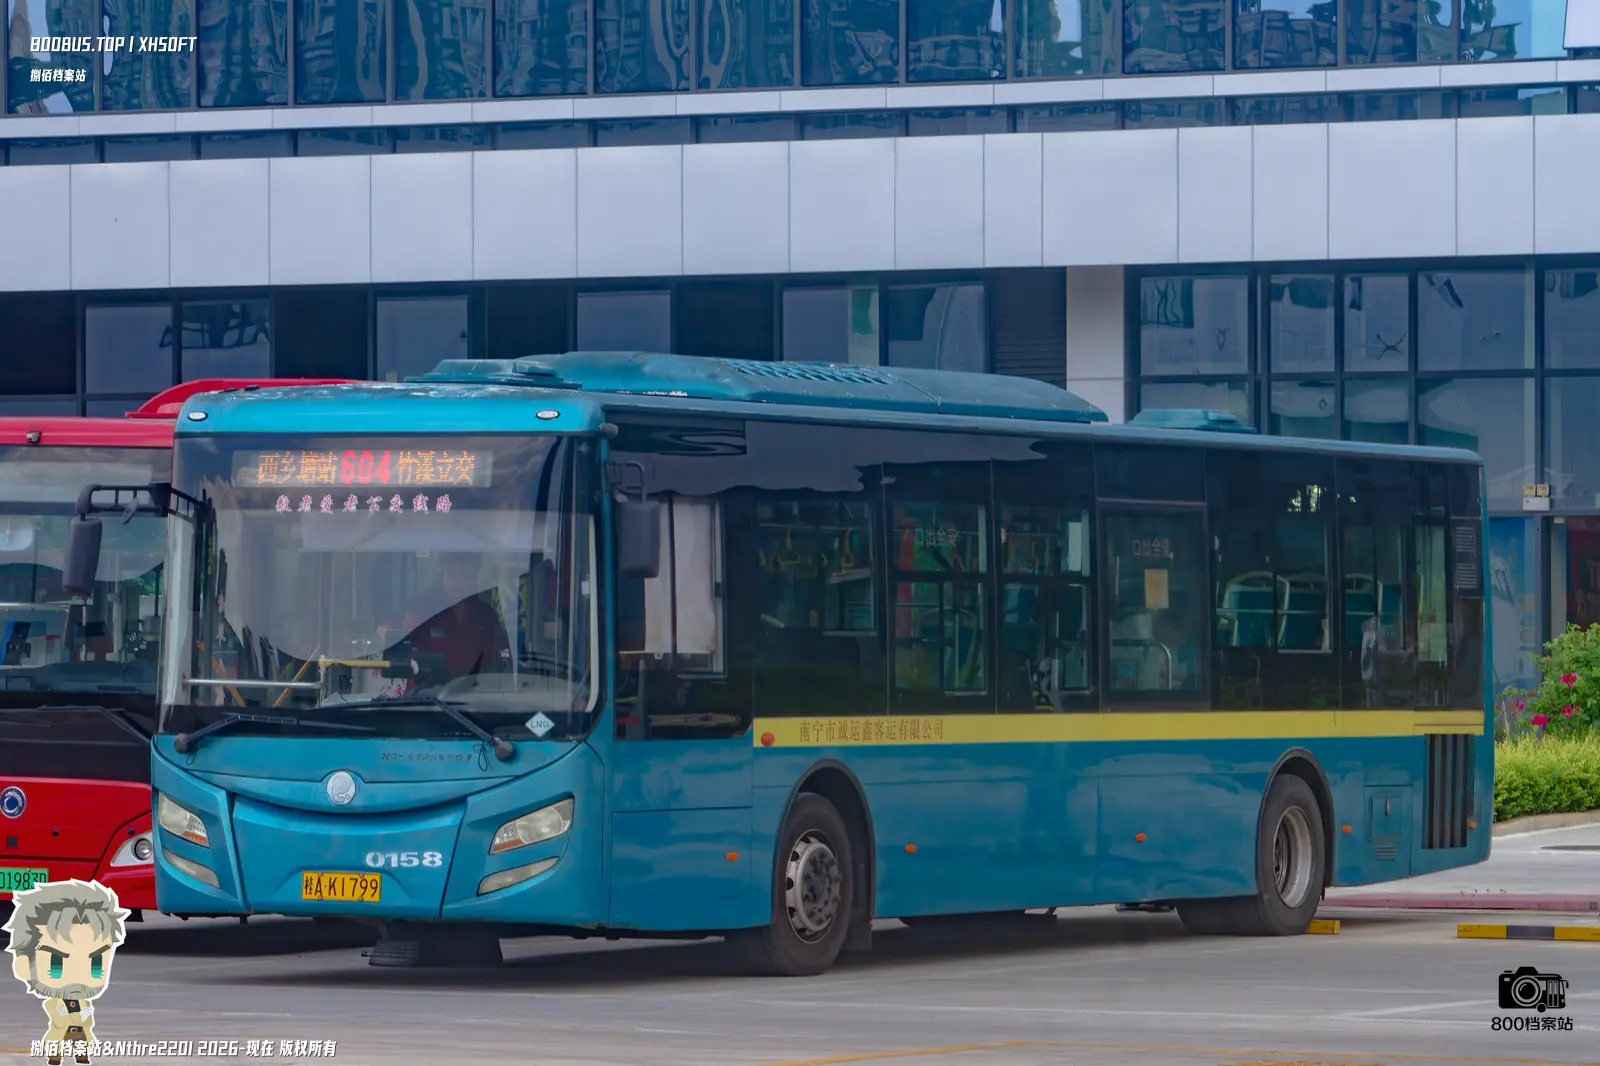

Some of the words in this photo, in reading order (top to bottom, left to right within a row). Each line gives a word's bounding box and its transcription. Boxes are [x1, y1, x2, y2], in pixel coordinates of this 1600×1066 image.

[258, 450, 338, 485] 西乡塘站
[341, 450, 392, 485] 604
[396, 449, 475, 485] 竹溪立交
[530, 720, 550, 729] LNG
[800, 719, 944, 742] 南宁市诚运鑫客运有限公司
[365, 851, 443, 868] 0158
